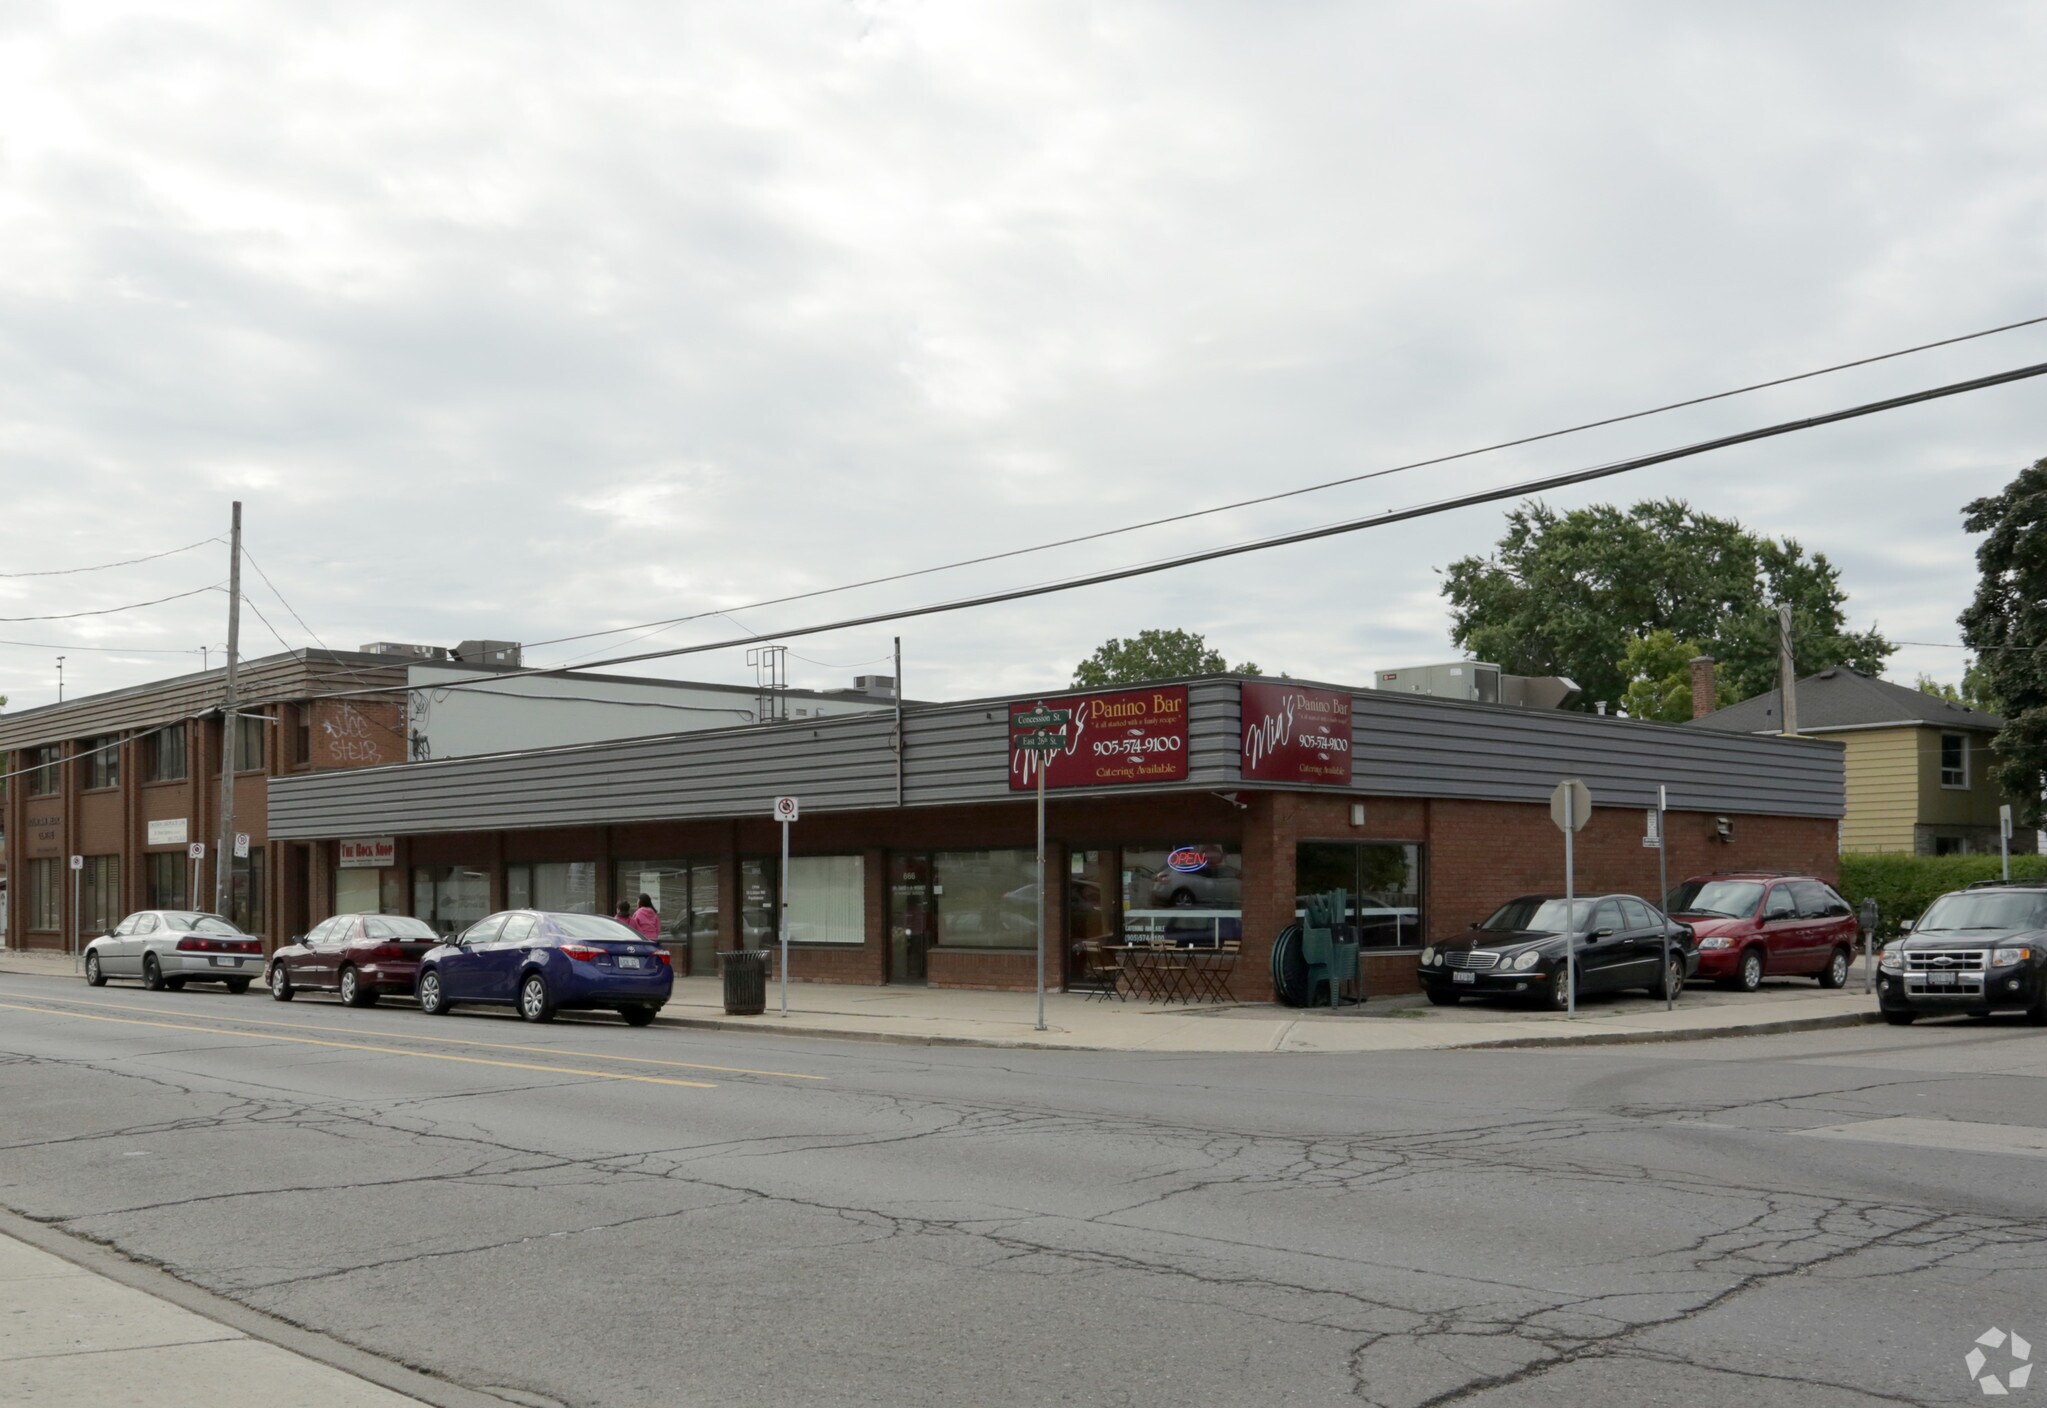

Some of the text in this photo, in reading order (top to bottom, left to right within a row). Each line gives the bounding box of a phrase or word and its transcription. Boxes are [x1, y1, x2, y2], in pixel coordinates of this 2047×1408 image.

[1091, 694, 1182, 719] Panino Bar
[1297, 695, 1348, 714] Panino Bar
[1017, 715, 1051, 724] Concession
[1245, 694, 1295, 770] Mia's
[1023, 737, 1035, 745] East
[1093, 735, 1181, 756] 905-574-9100
[1299, 734, 1348, 752] 905-574-9100
[1096, 763, 1176, 778] Catering Available
[1299, 764, 1323, 776] Catering
[1170, 852, 1206, 865] OPEN
